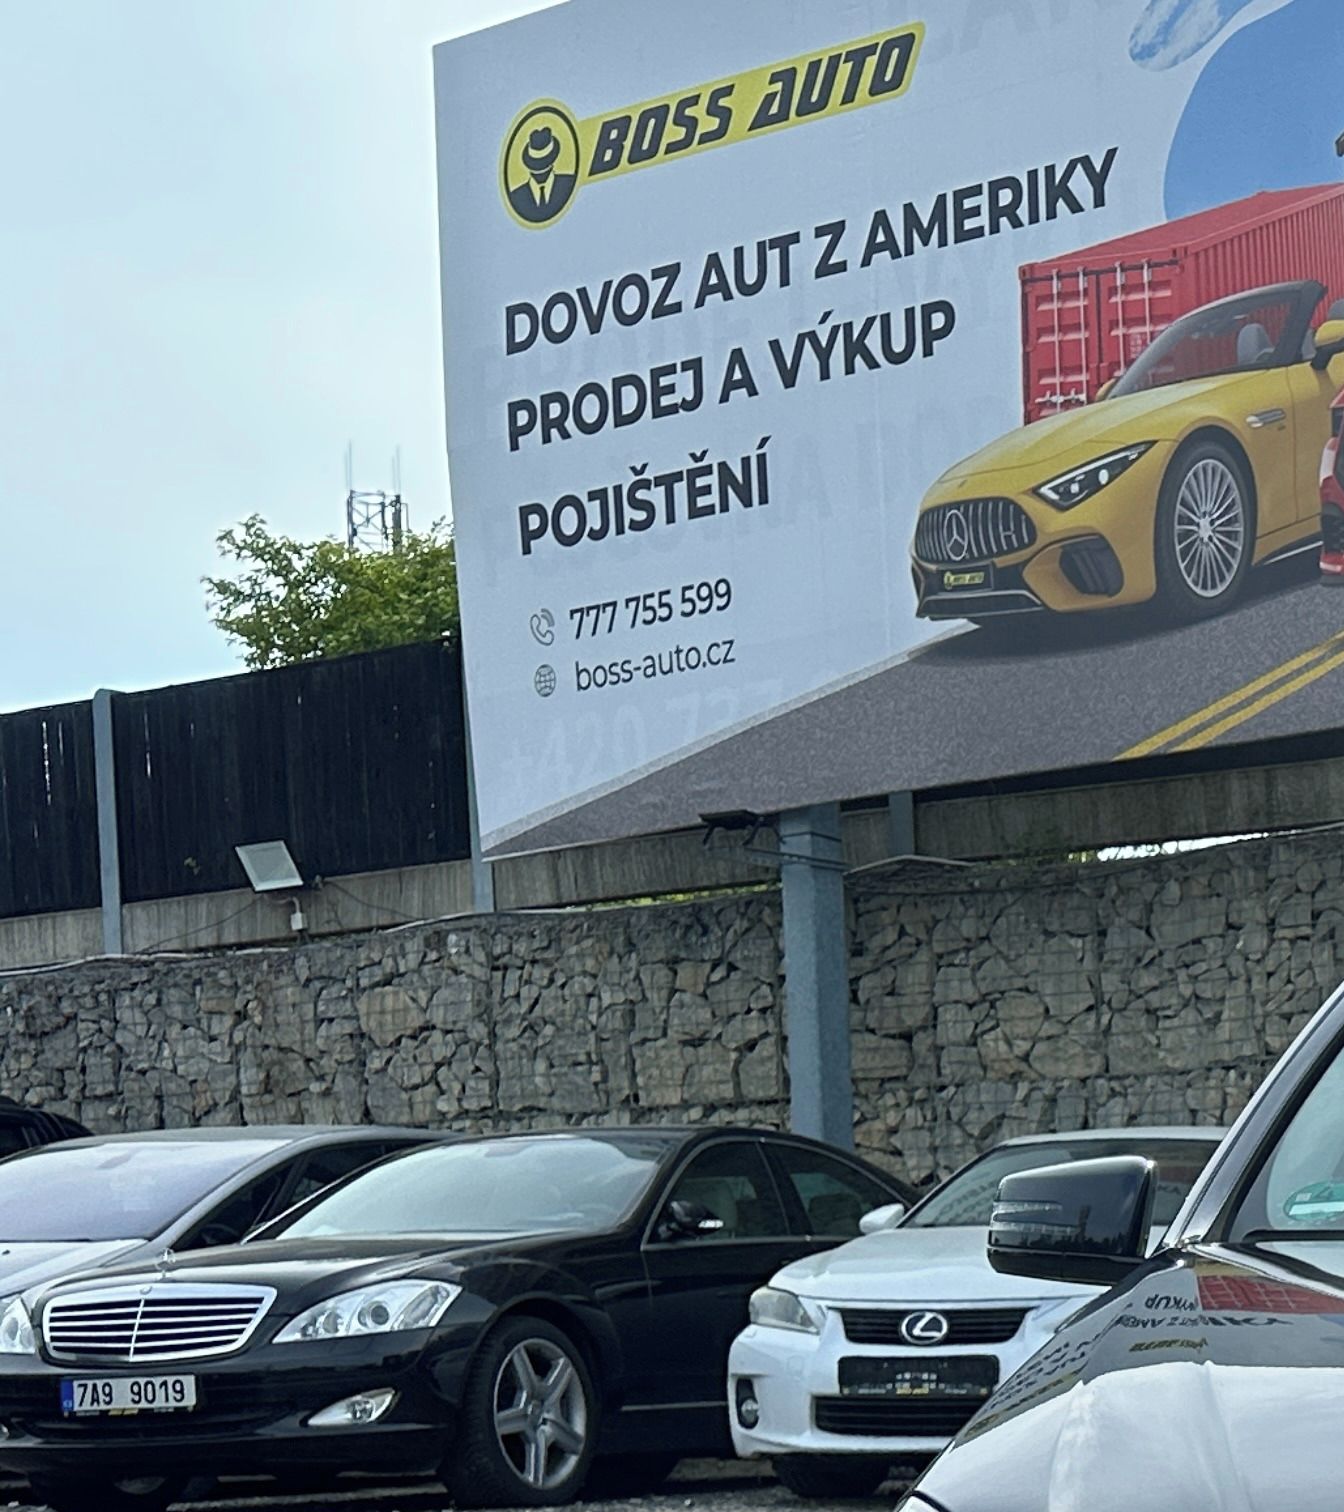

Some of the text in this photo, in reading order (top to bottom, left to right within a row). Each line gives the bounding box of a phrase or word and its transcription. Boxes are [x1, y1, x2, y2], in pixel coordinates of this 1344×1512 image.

[588, 32, 916, 176] BOSS AUTO
[506, 146, 1119, 355] DOVOZ AUT Z AMERIKY
[508, 300, 956, 452] PRODEJ A VÝKUP
[519, 435, 772, 556] POJIŠTĚNÍ
[569, 578, 732, 640] 777 755 599
[575, 639, 736, 692] boss-auto.cz
[77, 1379, 185, 1407] 7A9 9019
